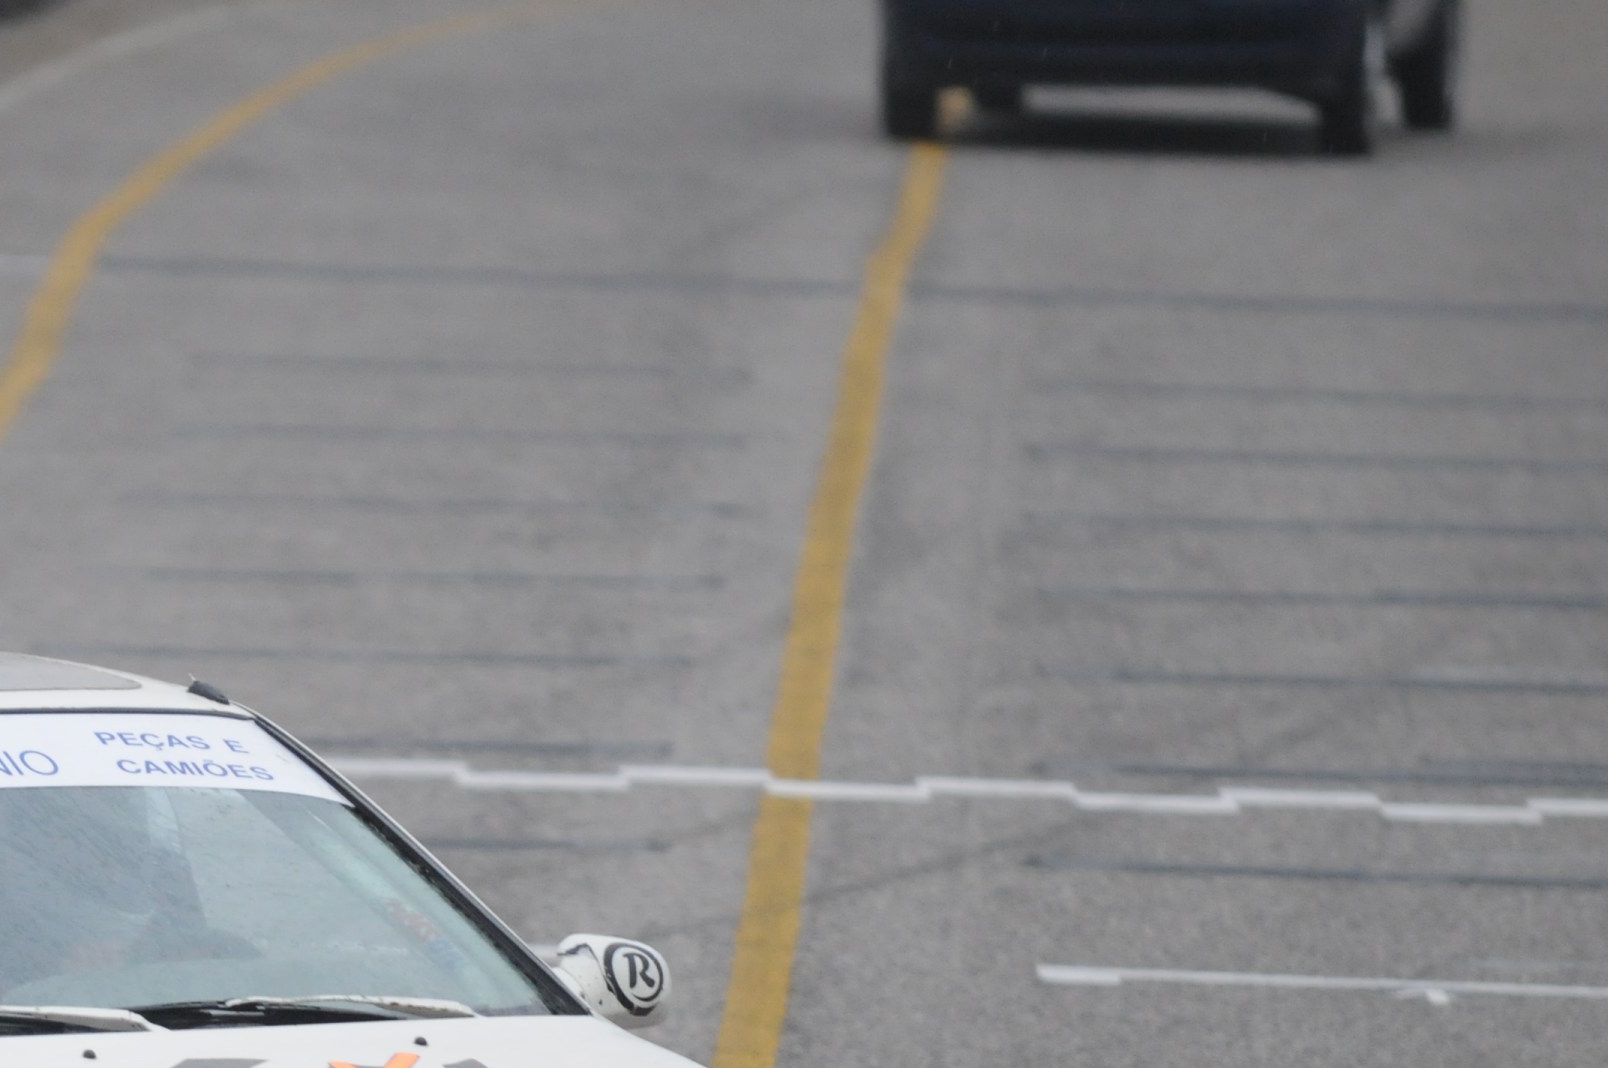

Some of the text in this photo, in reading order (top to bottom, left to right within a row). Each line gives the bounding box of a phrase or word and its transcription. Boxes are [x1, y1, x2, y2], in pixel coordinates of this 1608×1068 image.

[94, 731, 250, 754] PEÇAS E
[116, 759, 275, 781] CAMIÕES
